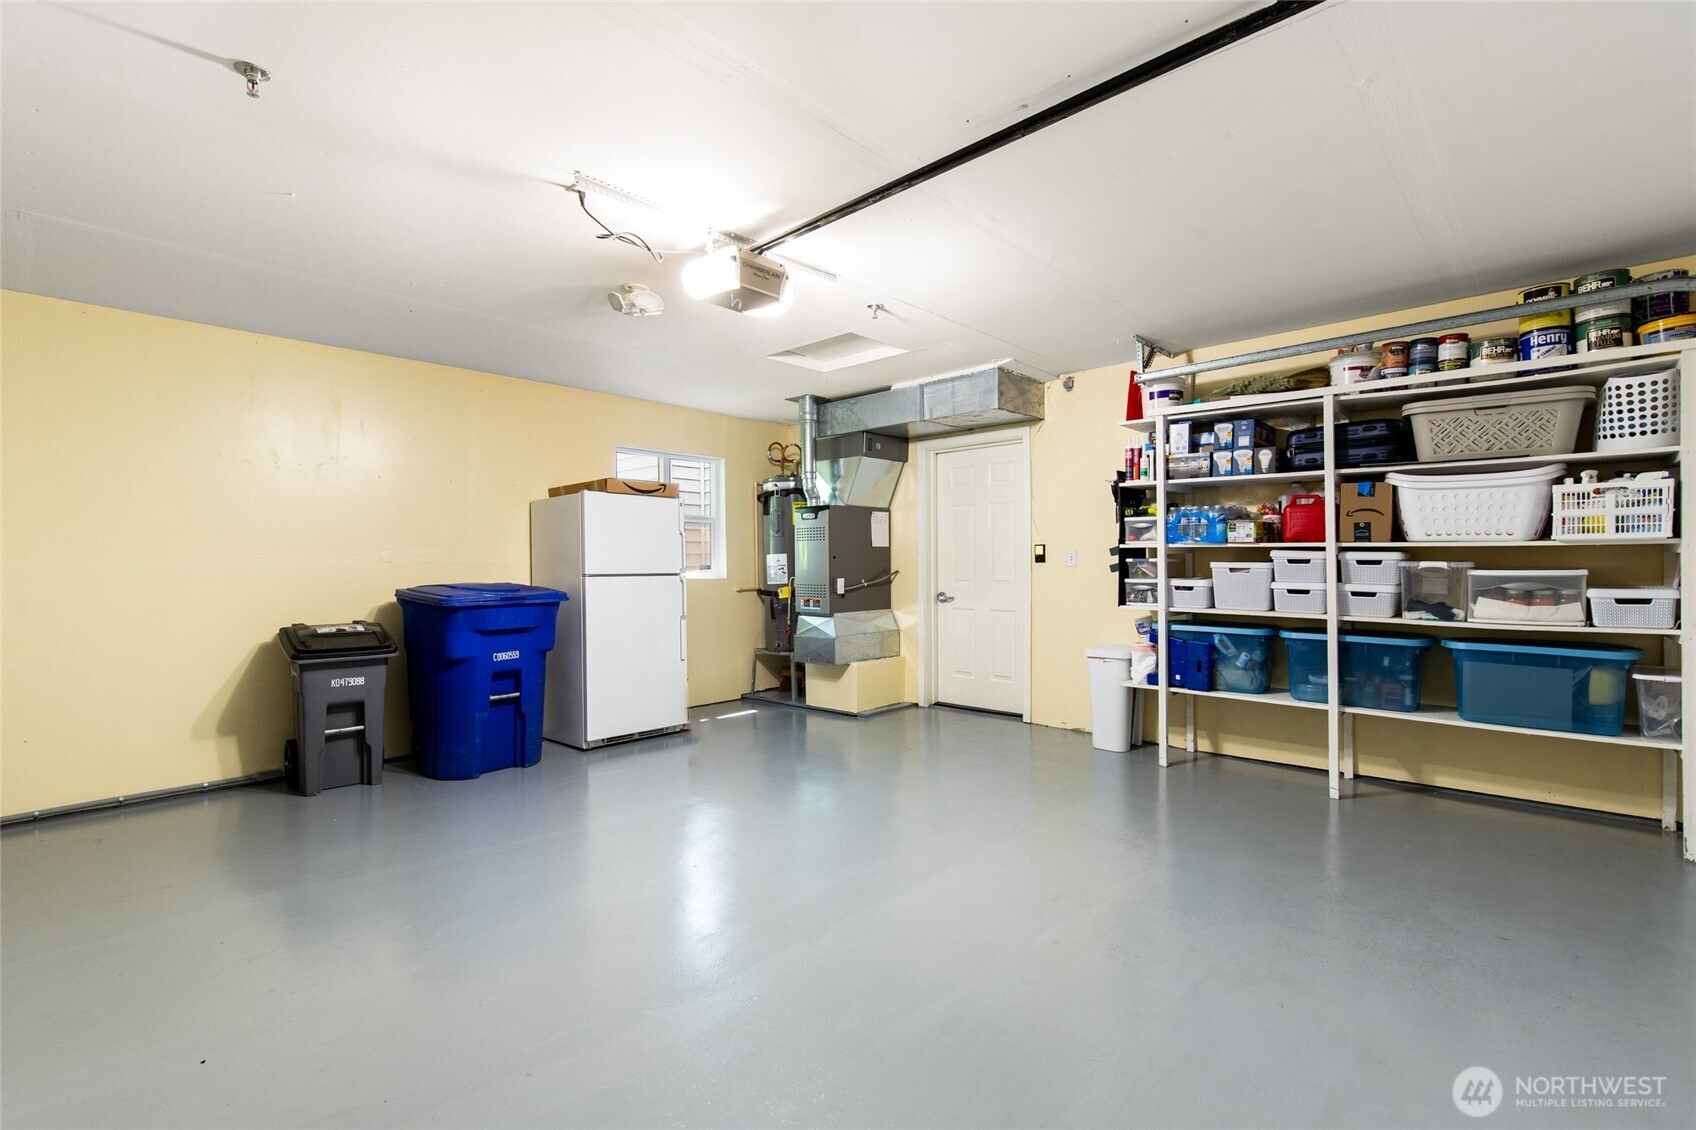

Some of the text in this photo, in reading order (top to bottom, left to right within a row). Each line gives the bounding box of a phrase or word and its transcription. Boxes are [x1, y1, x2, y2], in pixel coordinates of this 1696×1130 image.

[743, 261, 782, 280] CHAMBERLAIN
[1577, 280, 1602, 294] BEHR
[1530, 332, 1568, 346] Henry
[1589, 328, 1611, 339] BEHR
[1482, 345, 1505, 355] BEHR
